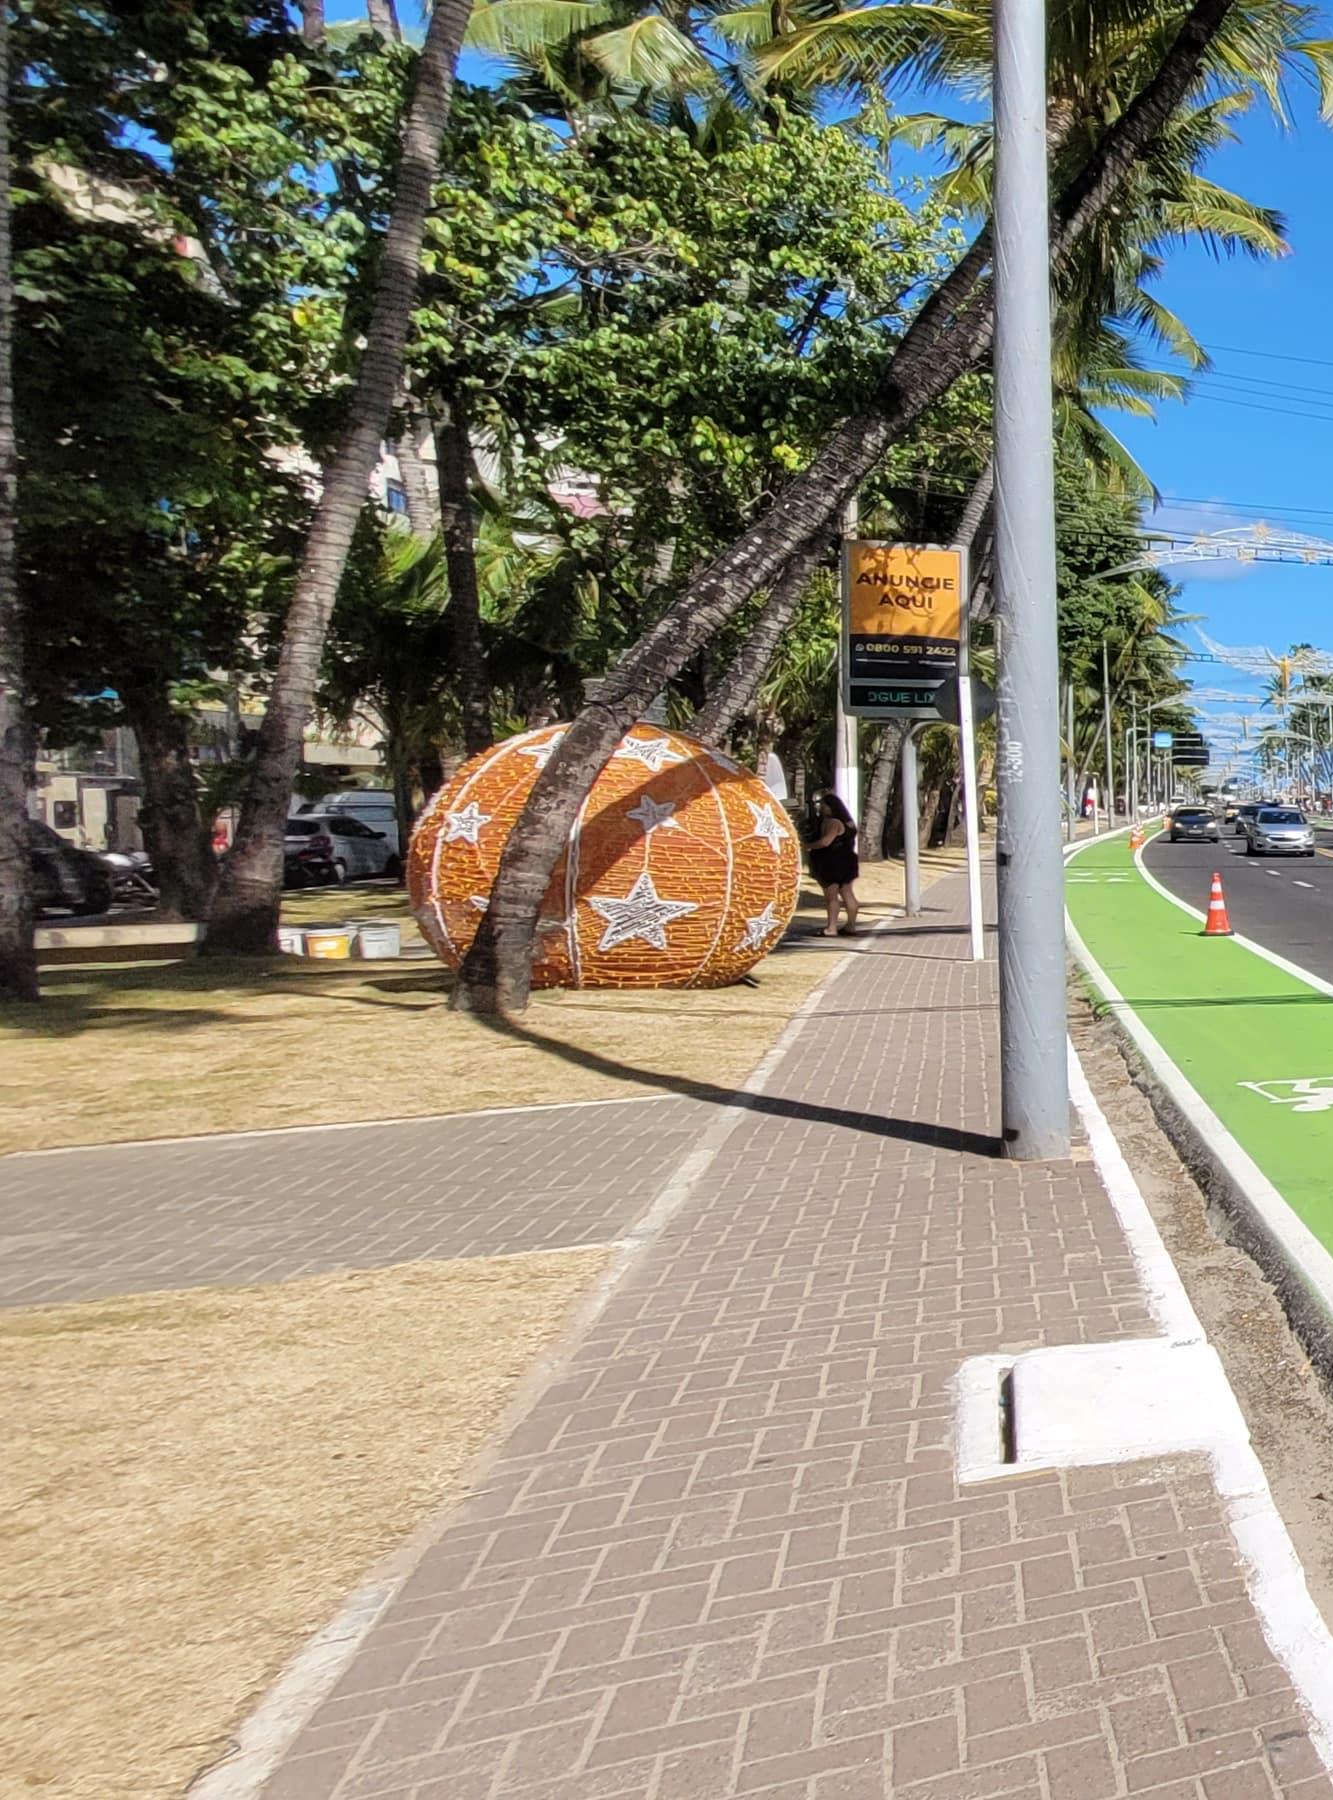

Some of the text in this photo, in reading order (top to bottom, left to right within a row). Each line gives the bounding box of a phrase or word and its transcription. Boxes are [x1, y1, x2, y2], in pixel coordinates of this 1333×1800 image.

[856, 572, 955, 590] ANUNCIE
[879, 592, 932, 609] AQUI
[866, 643, 900, 653] 0800
